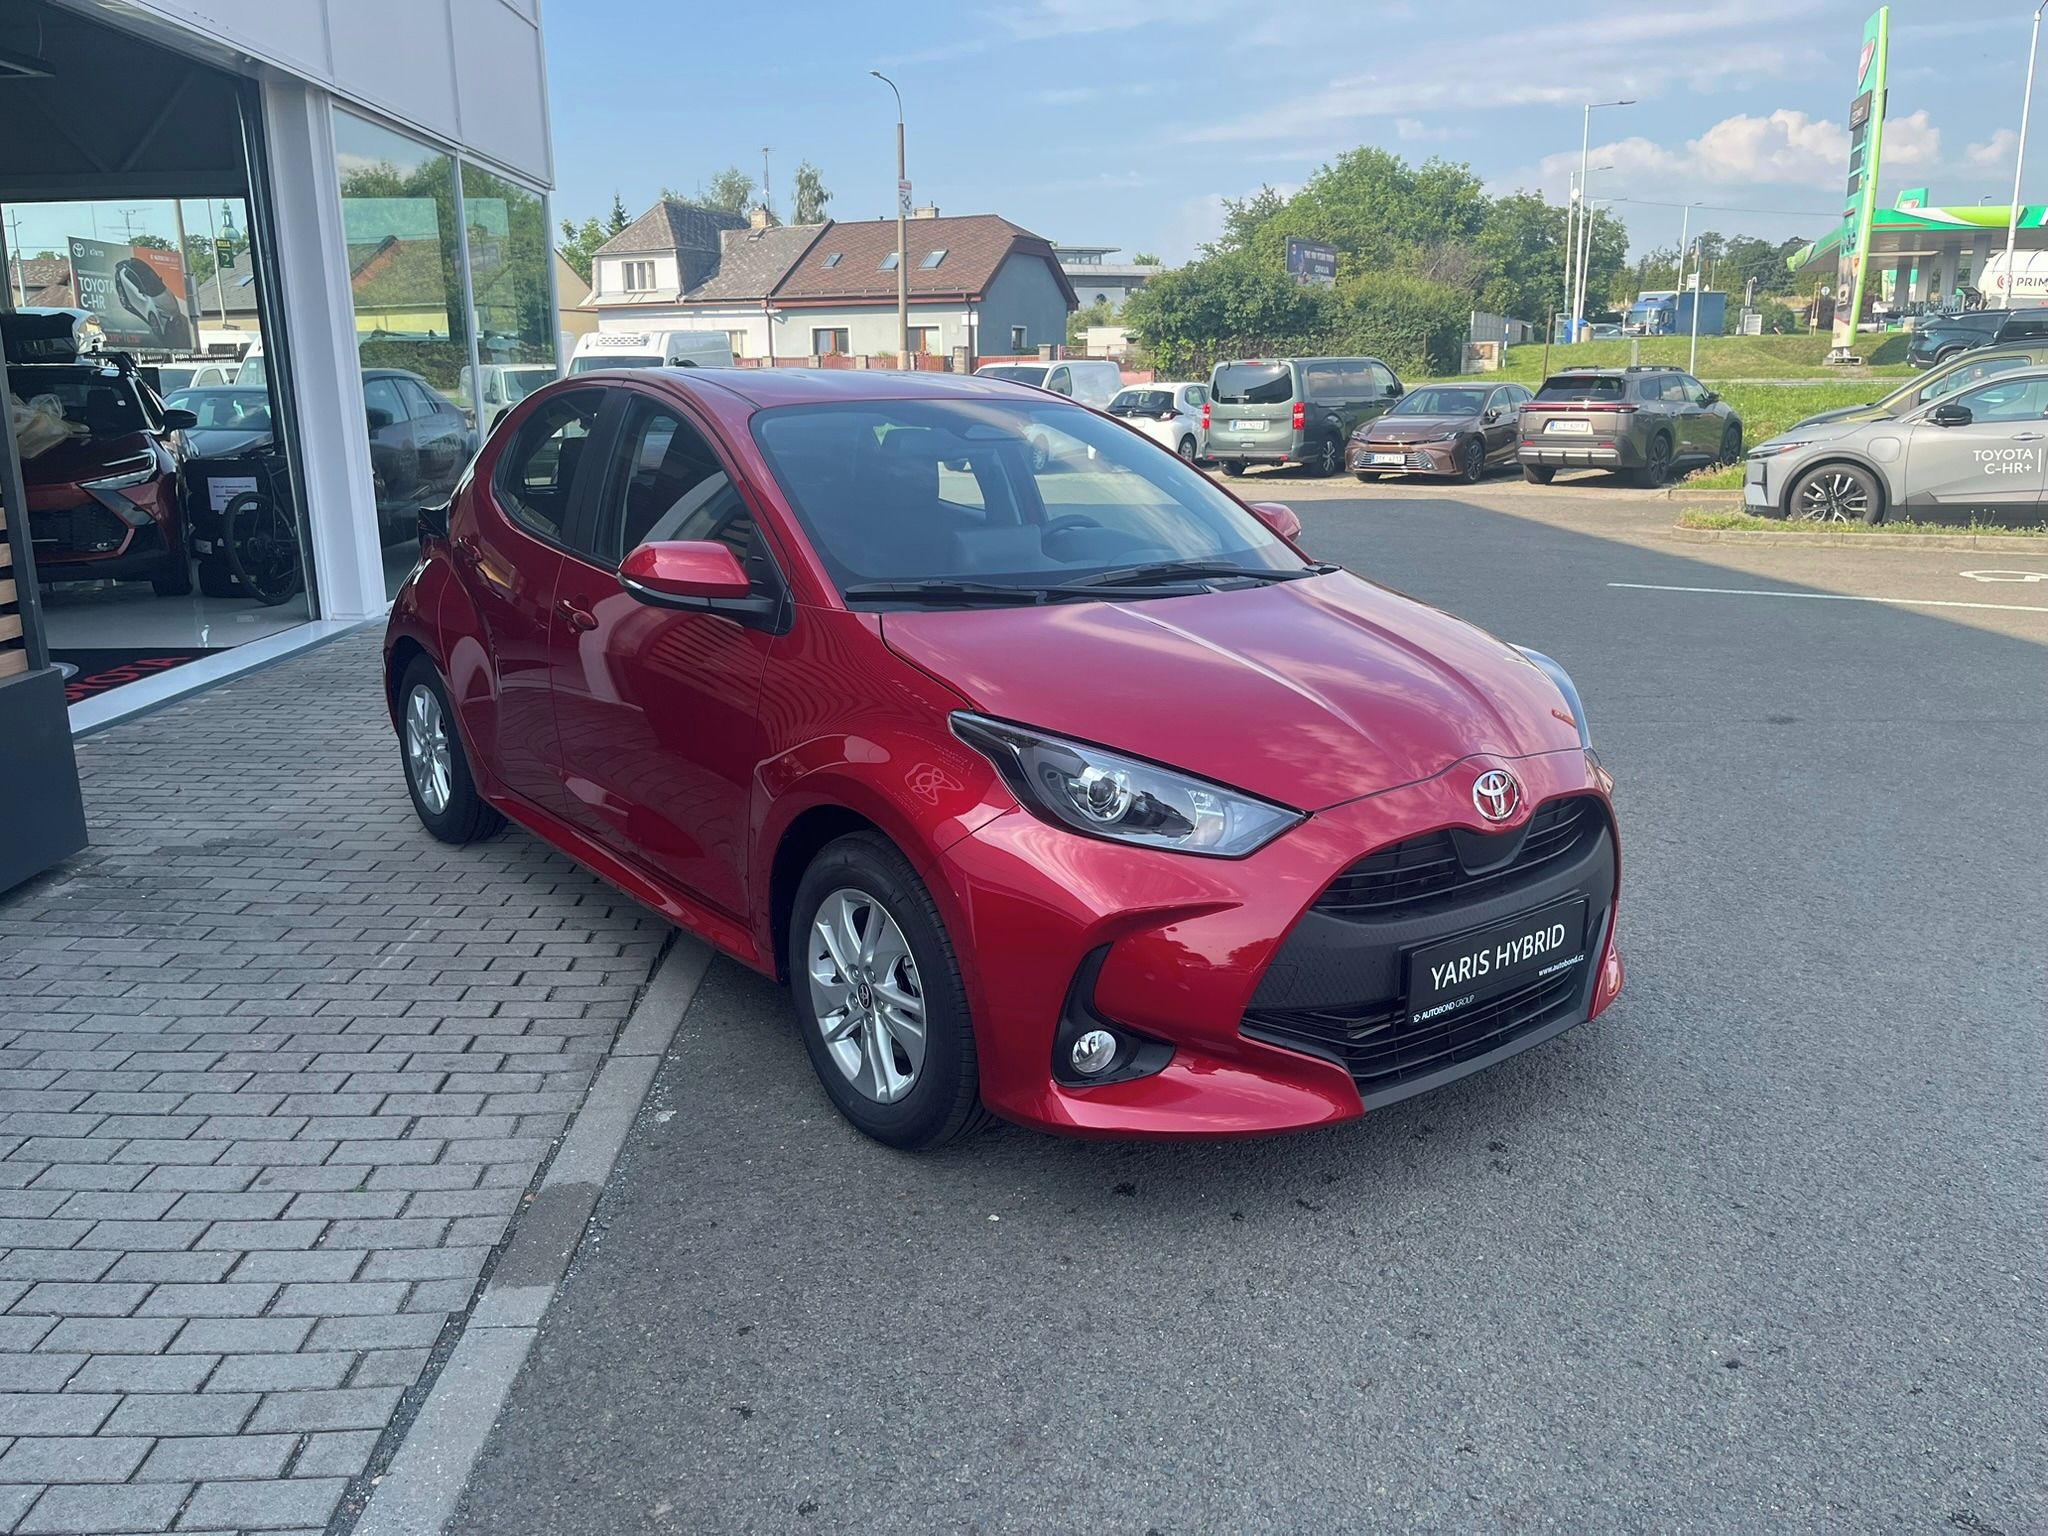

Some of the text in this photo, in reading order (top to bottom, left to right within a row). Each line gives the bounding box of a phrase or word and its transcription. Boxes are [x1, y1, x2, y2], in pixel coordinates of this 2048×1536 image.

[77, 276, 115, 294] TOYOTA
[81, 295, 106, 310] C-HR
[1972, 448, 2034, 462] TOYOTA
[1984, 462, 2033, 475] C-HR+
[64, 656, 191, 700] YOTA
[1430, 923, 1566, 991] YARIS HYBRID
[1538, 954, 1585, 977] www.autobond.cz
[1421, 994, 1475, 1020] AUTOBOND GROUP
